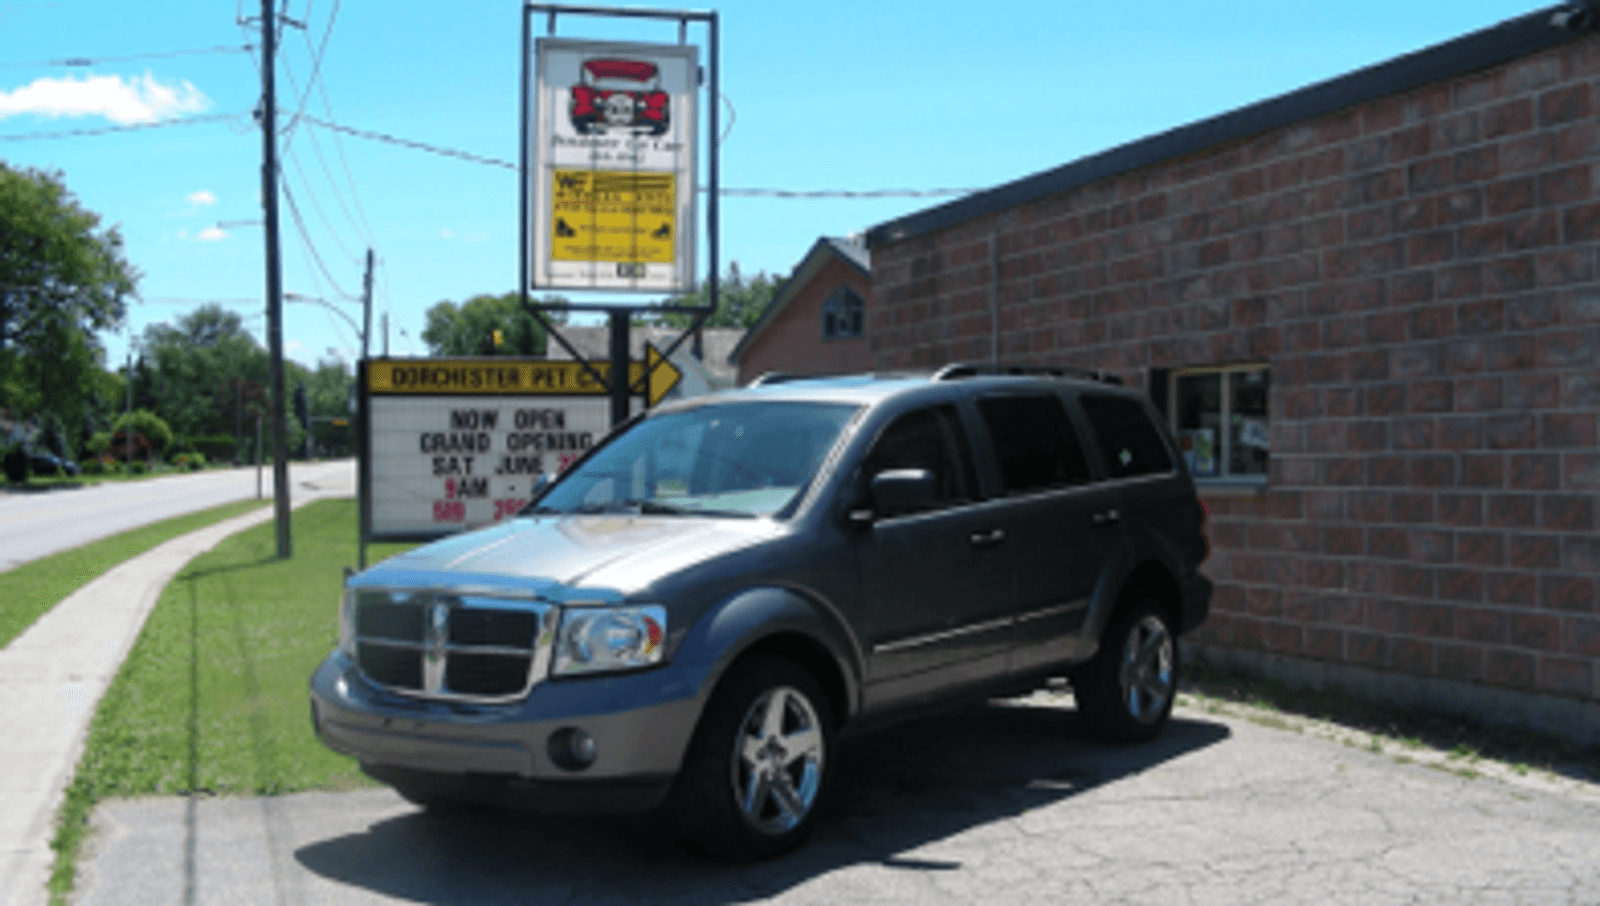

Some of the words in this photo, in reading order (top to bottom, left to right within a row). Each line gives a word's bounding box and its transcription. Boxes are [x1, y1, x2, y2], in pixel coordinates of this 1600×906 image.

[392, 367, 519, 388] DORCHESTER
[533, 367, 566, 388] PET
[451, 408, 499, 430] NOW
[514, 408, 565, 430] OPEN
[506, 431, 593, 452] OPENING
[432, 456, 475, 475] SAT
[495, 455, 545, 475] JUNE
[444, 477, 489, 500] 9AM
